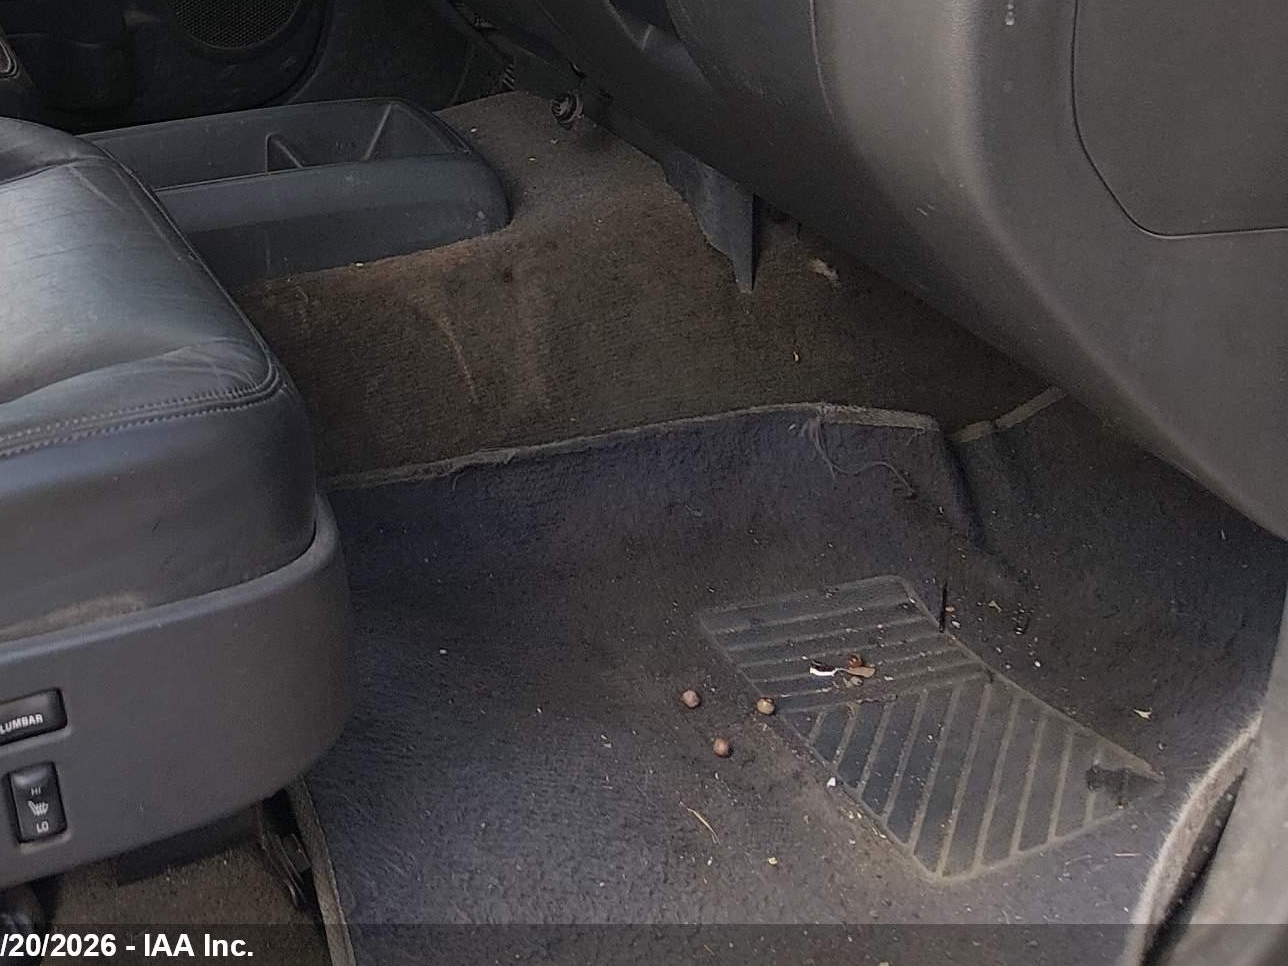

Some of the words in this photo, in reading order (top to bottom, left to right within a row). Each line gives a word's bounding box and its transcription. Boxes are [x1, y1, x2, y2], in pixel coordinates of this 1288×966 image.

[0, 713, 44, 735] LUMBAR
[30, 786, 42, 796] HI
[35, 820, 49, 834] LO
